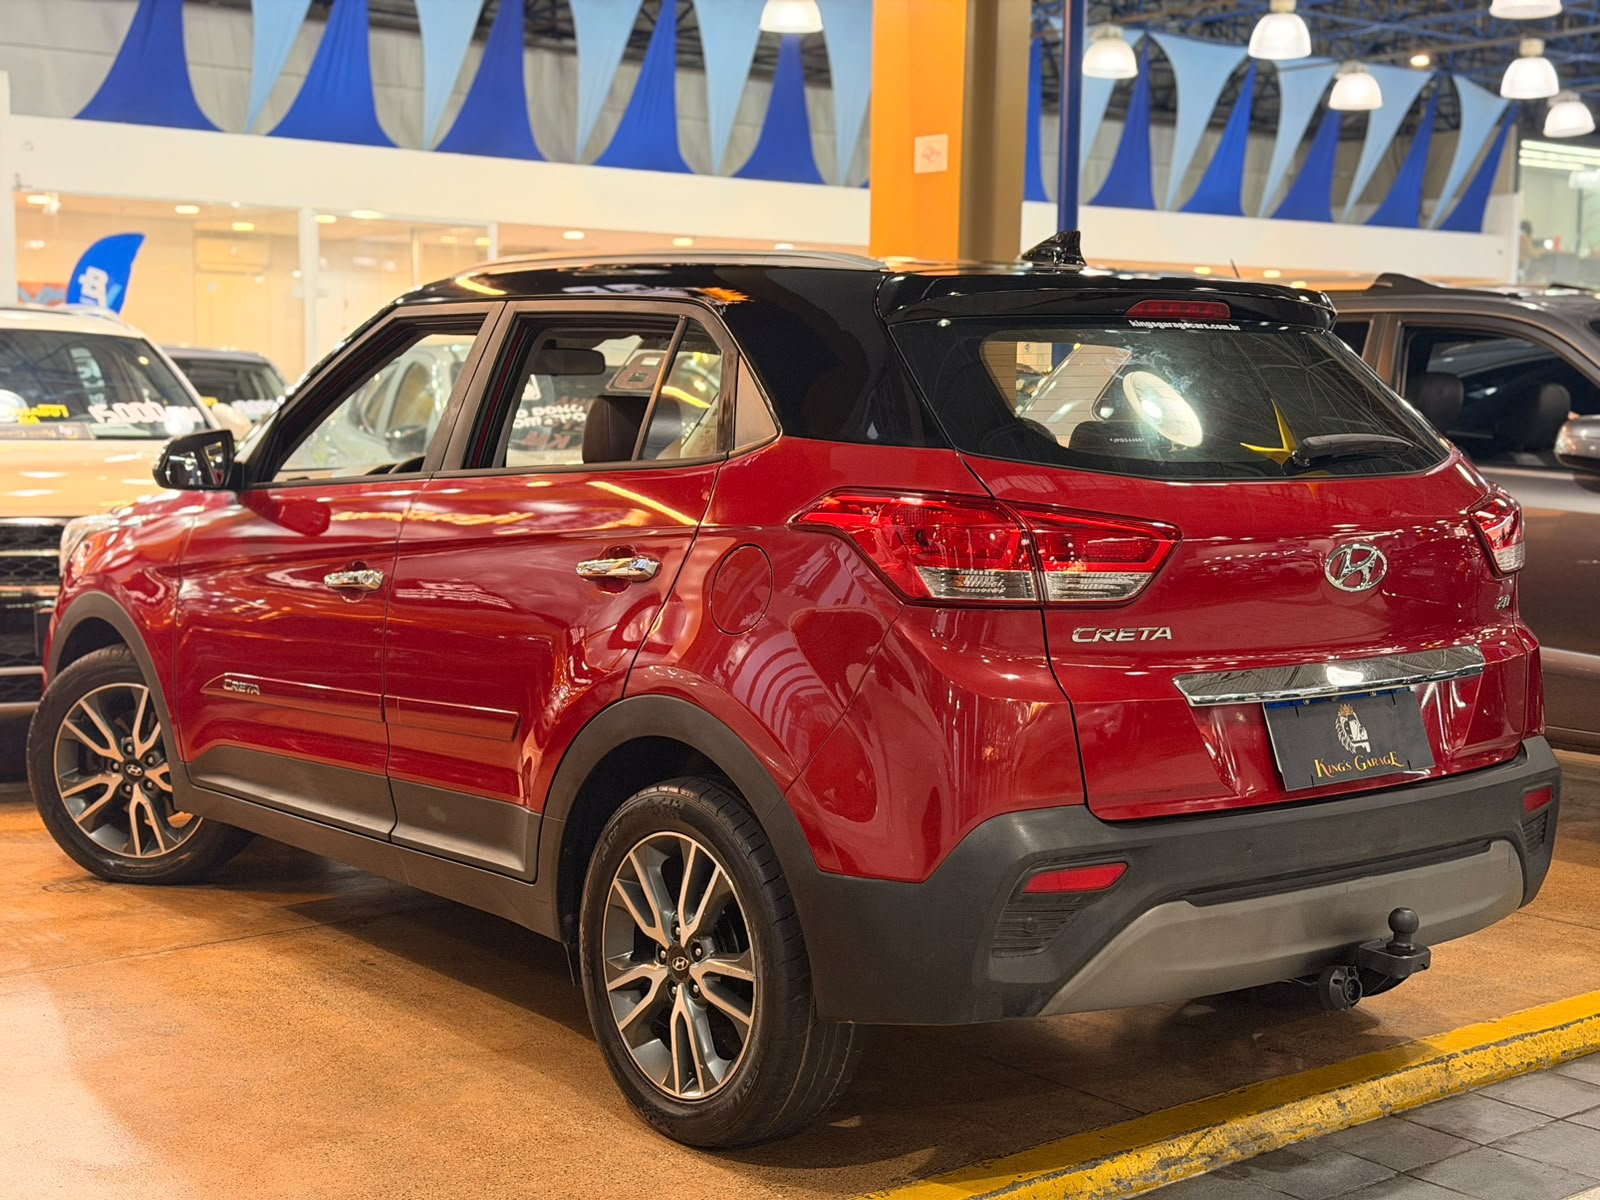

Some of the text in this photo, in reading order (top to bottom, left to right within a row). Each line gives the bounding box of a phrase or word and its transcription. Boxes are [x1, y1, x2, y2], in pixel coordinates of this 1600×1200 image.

[1071, 626, 1173, 643] CRETA
[222, 678, 261, 695] CRETA
[1313, 751, 1405, 779] KING'S GARAGE
